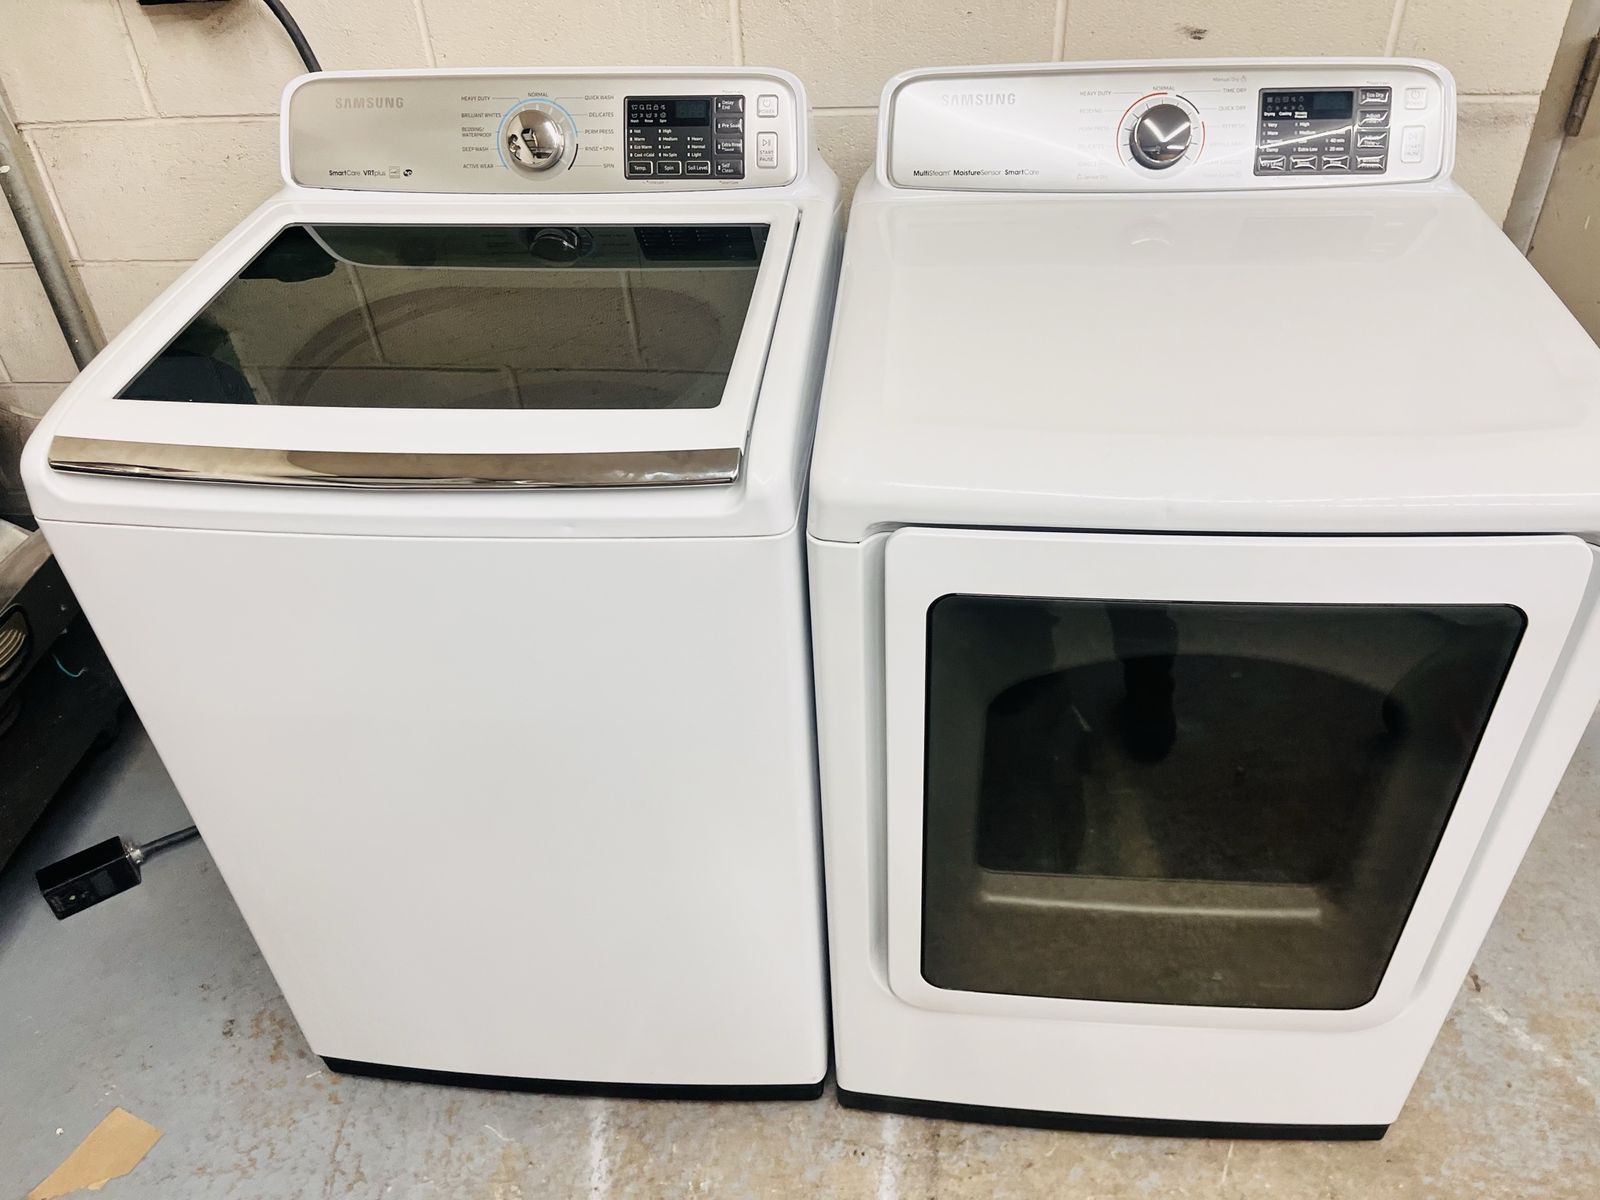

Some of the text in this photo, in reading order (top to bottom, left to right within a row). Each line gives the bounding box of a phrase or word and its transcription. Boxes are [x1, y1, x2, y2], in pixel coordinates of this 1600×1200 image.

[335, 97, 405, 109] SAMSUNG
[942, 93, 1016, 106] SAMSUNG
[329, 169, 361, 177] SmartCare
[953, 169, 1002, 177] MoistureSensor
